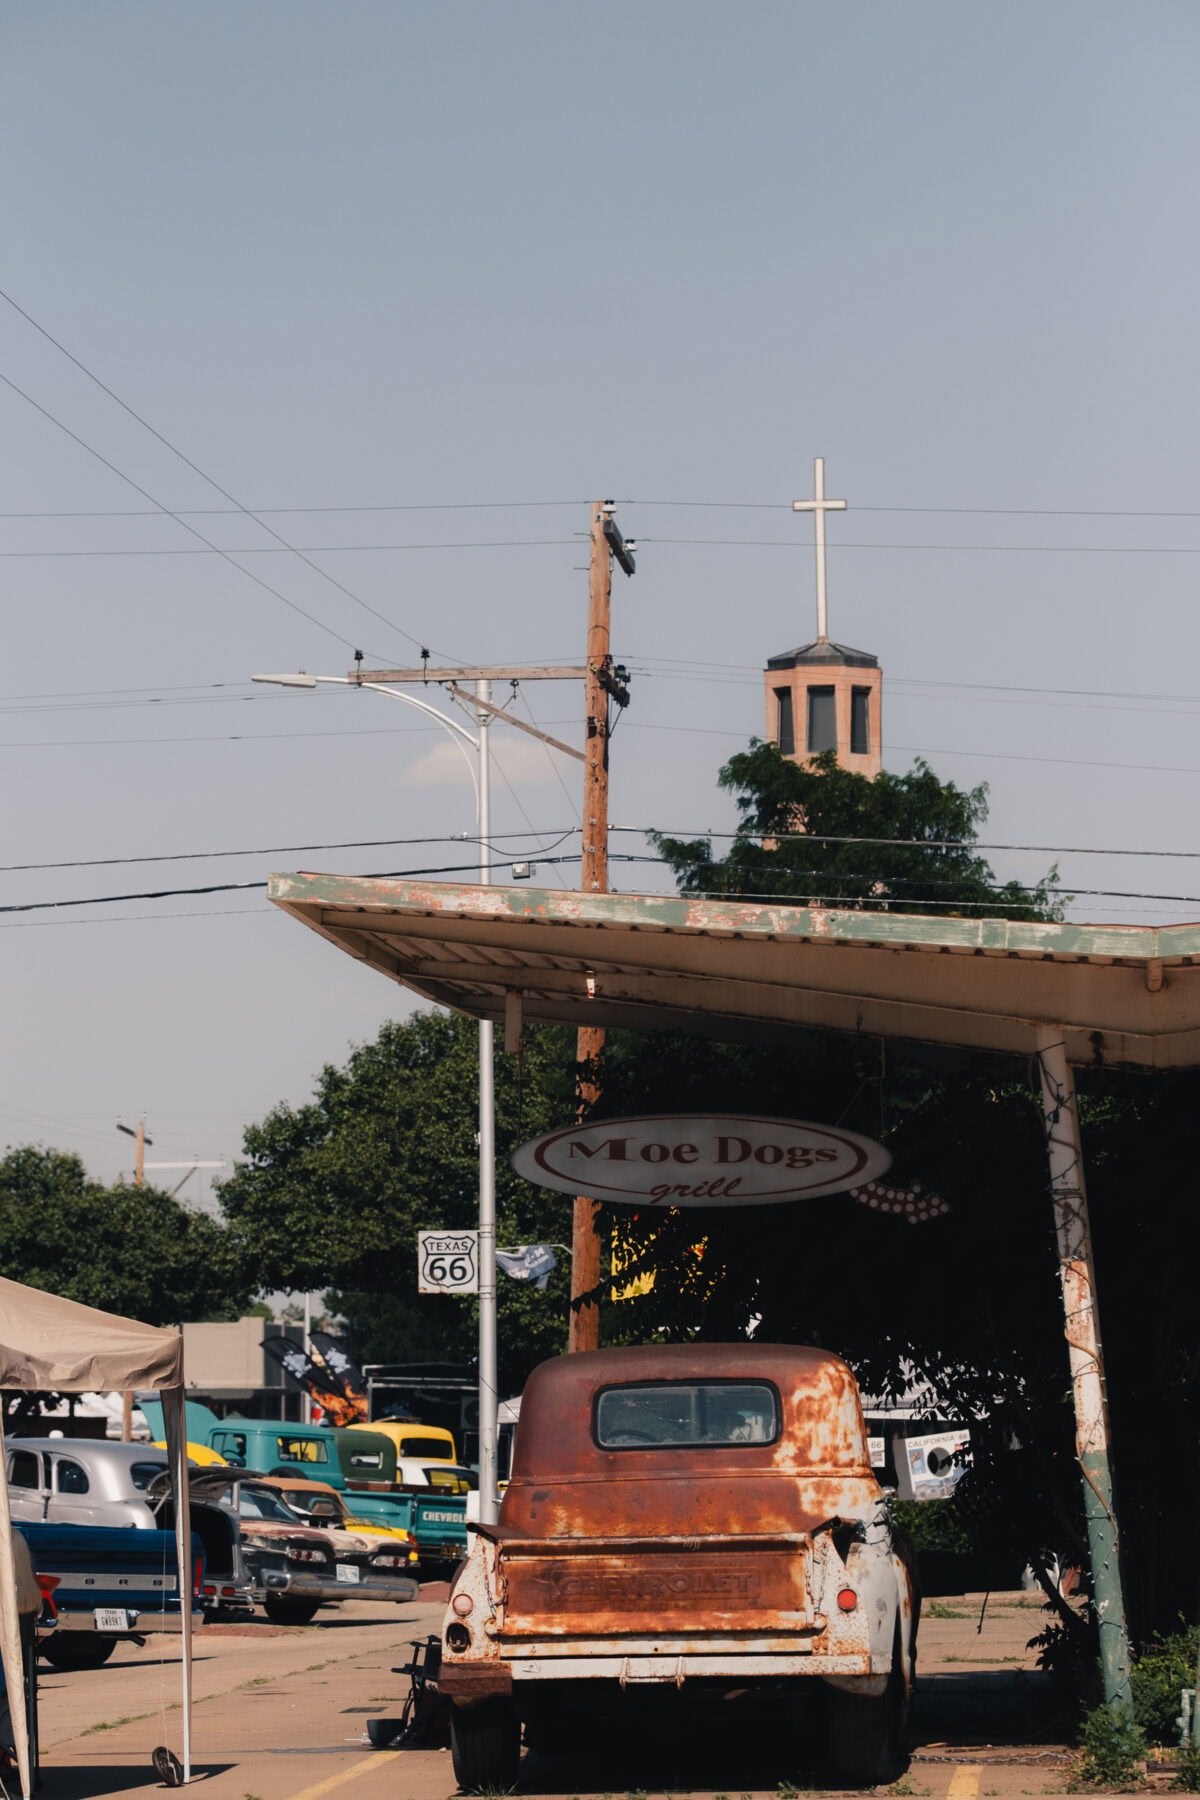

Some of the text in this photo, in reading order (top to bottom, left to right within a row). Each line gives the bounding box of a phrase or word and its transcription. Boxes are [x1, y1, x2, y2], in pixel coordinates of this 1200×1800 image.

[567, 1136, 839, 1169] Moe Dogs
[648, 1176, 742, 1204] grill
[428, 1241, 469, 1251] TEXAS
[429, 1257, 467, 1281] 66
[907, 1433, 968, 1449] CALIFORNIA 66
[422, 1511, 468, 1524] CHEVROL
[559, 1572, 753, 1596] CHEVROLET
